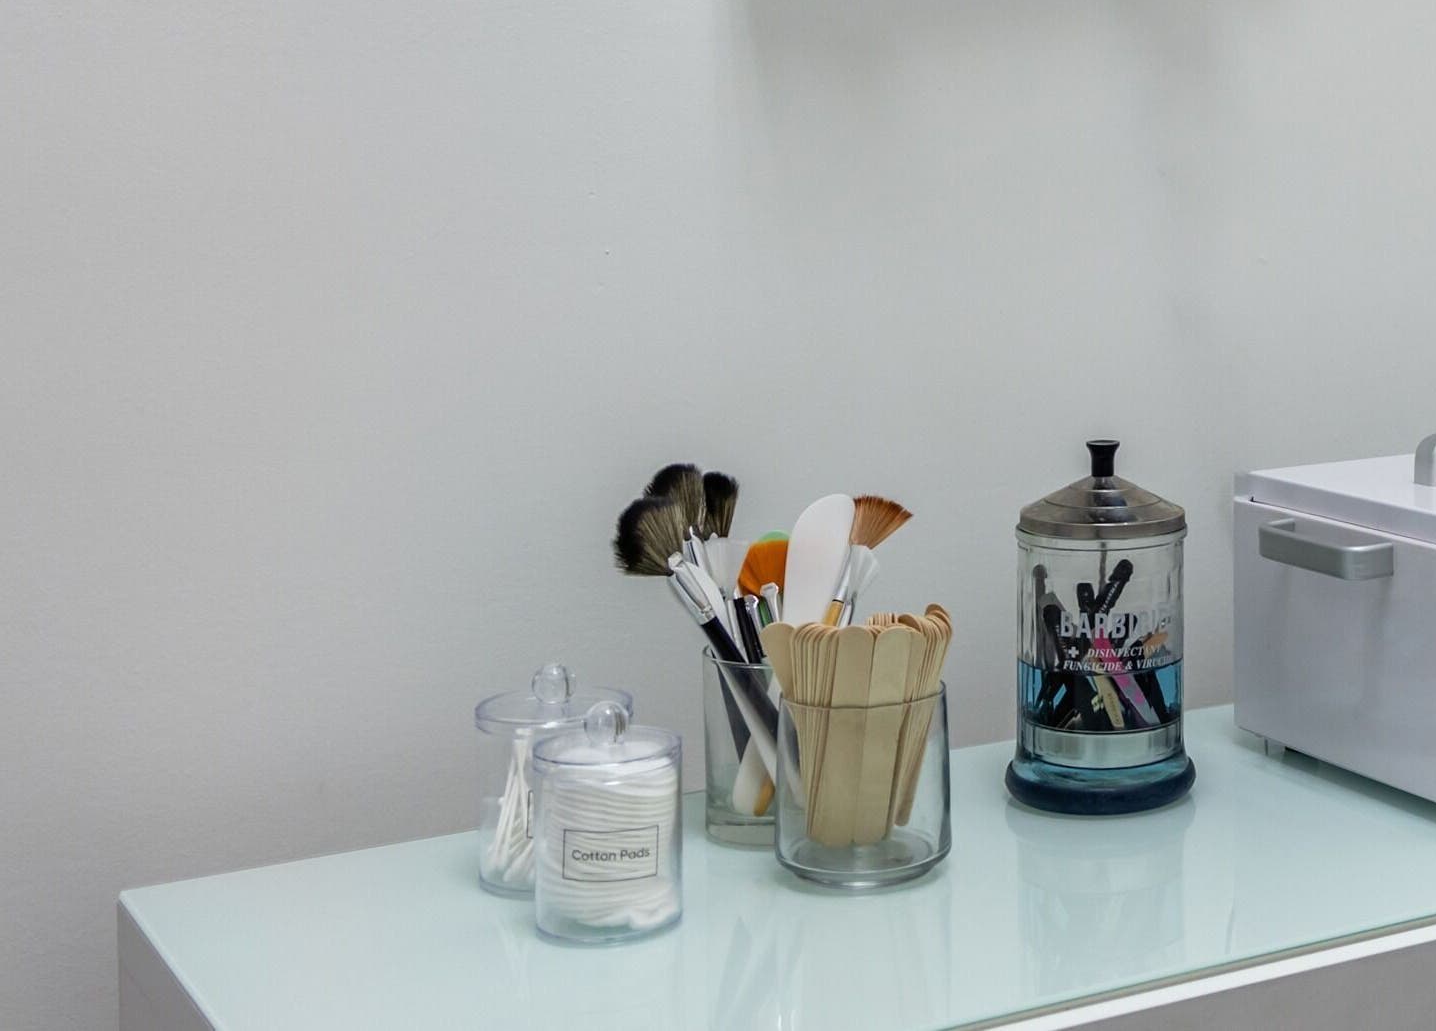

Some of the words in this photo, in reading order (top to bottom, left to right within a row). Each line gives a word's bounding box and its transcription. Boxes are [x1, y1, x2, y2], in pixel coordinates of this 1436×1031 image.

[1063, 660, 1122, 671] FUNGICIDE
[1125, 659, 1133, 670] &
[571, 849, 617, 862] Cotton
[620, 847, 651, 860] Pads
